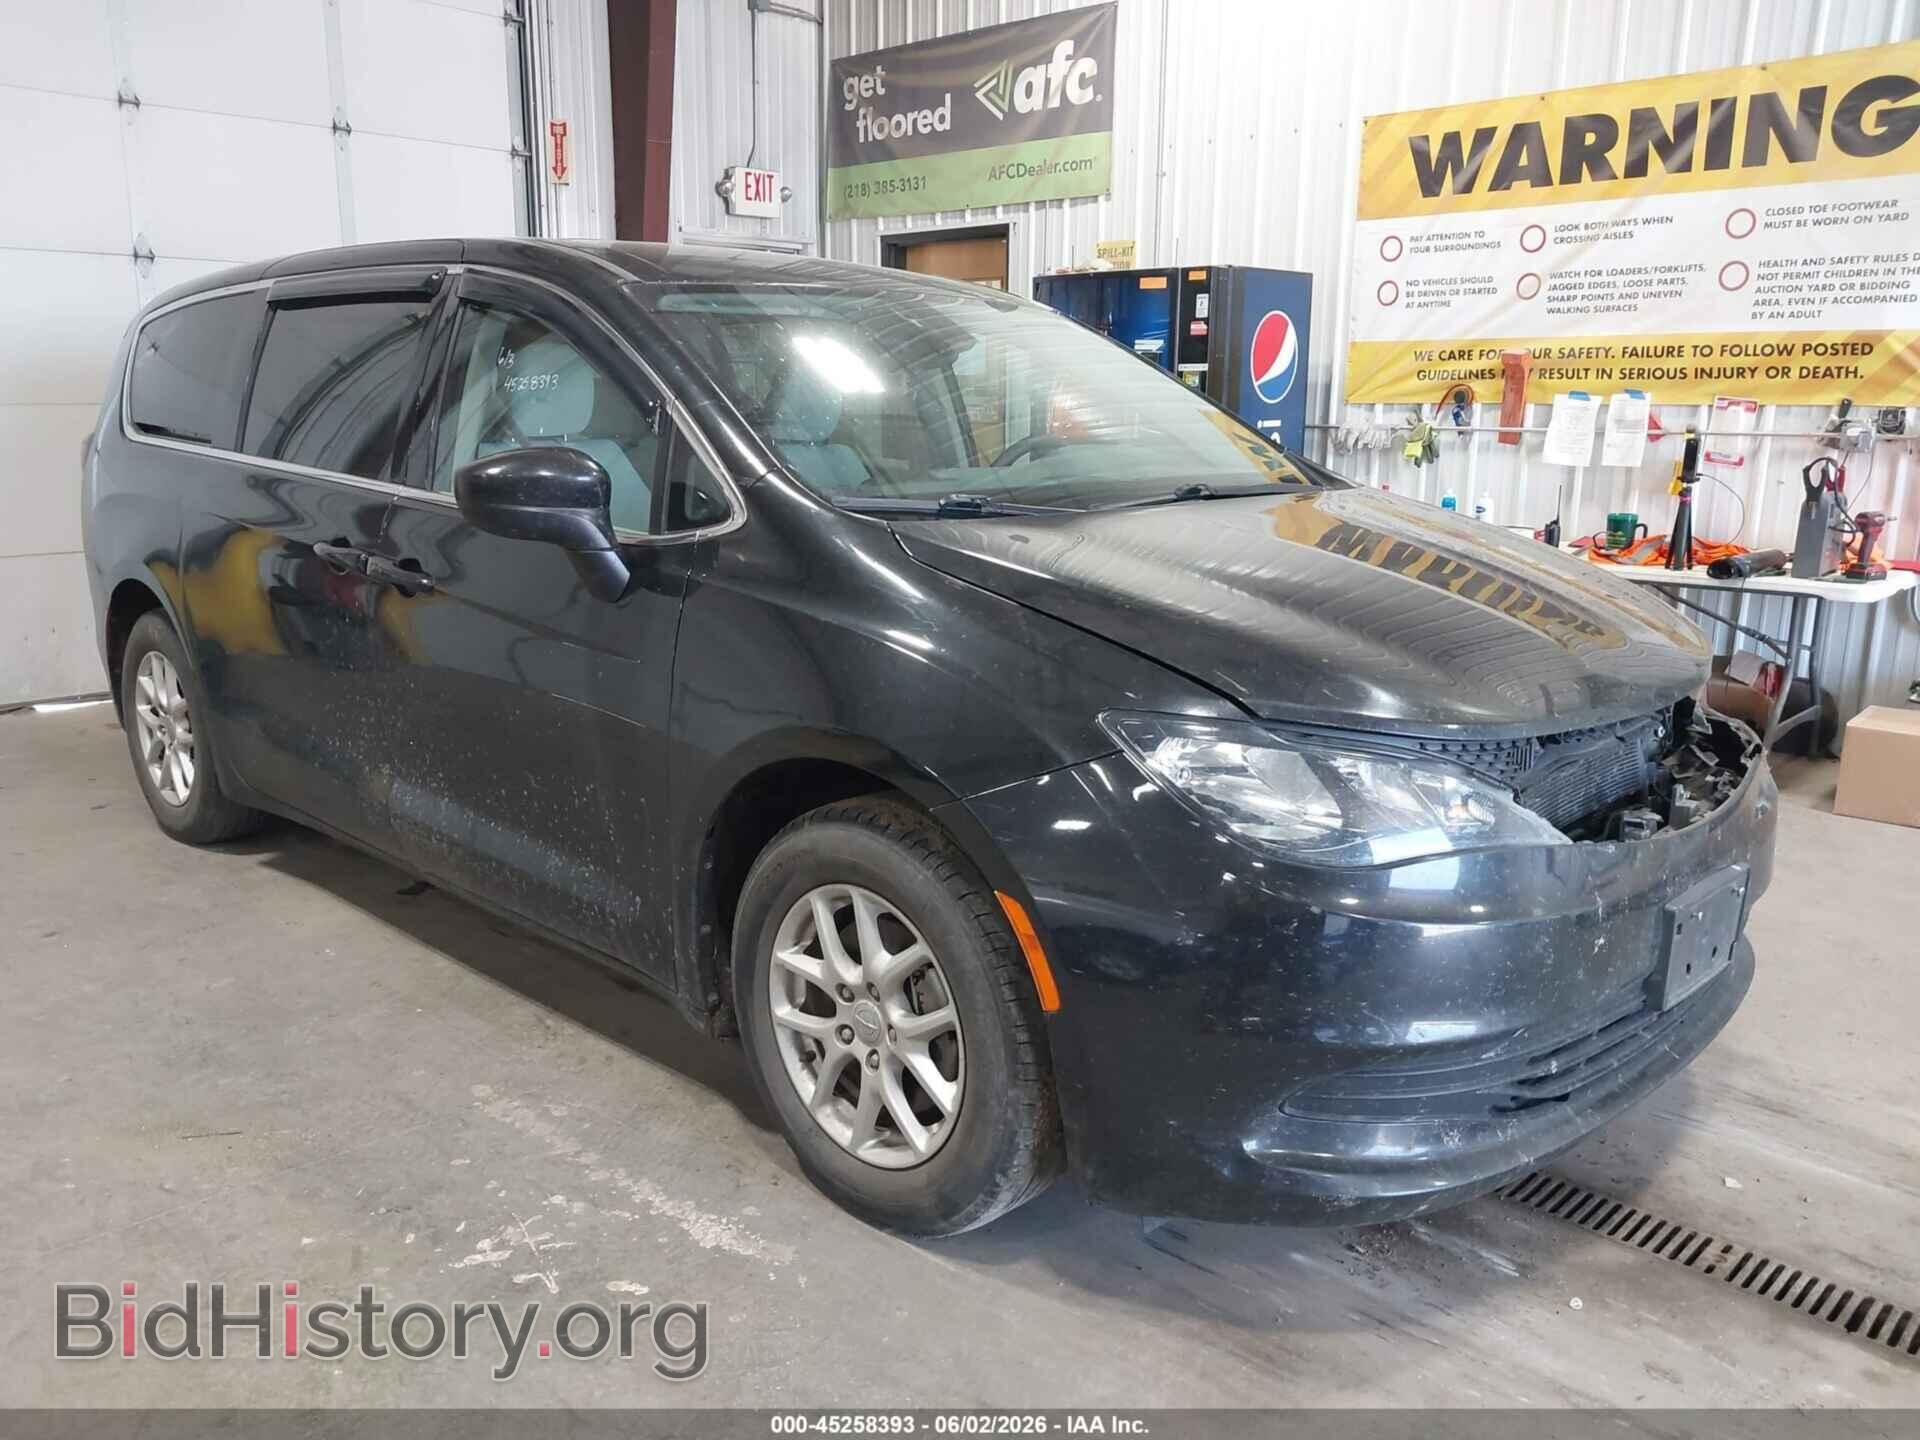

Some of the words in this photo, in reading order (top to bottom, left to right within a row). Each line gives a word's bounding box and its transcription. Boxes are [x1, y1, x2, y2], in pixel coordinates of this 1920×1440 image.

[843, 66, 885, 111] get
[856, 93, 951, 143] floored
[1408, 75, 1920, 198] WARNING
[989, 159, 1093, 181] AFCDealer.com
[745, 171, 774, 202] EXIT
[843, 180, 870, 200] (218)
[874, 176, 927, 195] 385-3131
[1765, 206, 1805, 217] CLOSED
[1809, 204, 1828, 214] TOE
[1832, 200, 1898, 212] FOOTWEAR
[1554, 224, 1580, 233] LOOK
[1584, 221, 1608, 231] BOTH
[1611, 218, 1639, 228] WAYS
[1642, 216, 1673, 225] WHEN
[1764, 220, 1793, 230] MUST
[1796, 219, 1809, 228] BE
[1812, 217, 1849, 227] WORN
[1854, 215, 1872, 224] ON
[1878, 212, 1909, 223] YARD
[1410, 235, 1424, 243] PAY
[1426, 232, 1472, 242] ATTENTION
[1474, 231, 1485, 239] TO
[1554, 234, 1601, 245] CROSSING
[1603, 231, 1634, 240] AISLES
[1410, 245, 1431, 254] YOUR
[1434, 241, 1501, 253] SURROUNDINGS
[1759, 259, 1798, 269] HEALTH
[1801, 258, 1826, 267] AND
[1830, 256, 1869, 265] SAFETY
[1873, 253, 1909, 263] RULES
[1550, 271, 1581, 280] WATCH
[1584, 270, 1603, 278] FOR
[1607, 264, 1706, 277] LOADERS/FORKLIFTS,
[1757, 273, 1780, 281] NOT
[1783, 271, 1821, 280] PERMIT
[1824, 268, 1879, 279] CHILDREN
[1882, 267, 1896, 276] IN
[1901, 266, 1920, 275] THE
[1423, 278, 1457, 286] VEHICLES
[1460, 276, 1494, 285] SHOULD
[1548, 282, 1584, 292] JAGGED
[1624, 279, 1653, 288] LOOSE
[1657, 277, 1689, 287] PARTS,
[1755, 285, 1803, 294] AUCTION
[1807, 283, 1836, 292] YARD
[1839, 283, 1856, 292] OR
[1860, 280, 1911, 291] BIDDING
[1463, 287, 1498, 296] STARTED
[1547, 295, 1577, 303] SHARP
[1581, 293, 1615, 302] POINTS
[1618, 292, 1639, 300] AND
[1643, 290, 1683, 299] UNEVEN
[1417, 300, 1451, 308] ANYTIME
[1788, 297, 1815, 306] EVEN
[1819, 297, 1828, 305] IF
[1831, 294, 1918, 305] ACCOMPANIED
[1546, 306, 1590, 315] WALKING
[1593, 304, 1639, 313] SURFACES
[1751, 312, 1765, 320] BY
[1768, 311, 1785, 320] AN
[1788, 310, 1822, 319] ADULT
[1414, 350, 1434, 362] WE
[1439, 349, 1473, 361] CARE
[1557, 347, 1616, 360] SAFETY.
[1621, 345, 1685, 359] FAILURE
[1692, 344, 1713, 358] TO
[1720, 343, 1796, 358] FOLLOW
[1801, 342, 1874, 356] POSTED
[1417, 368, 1496, 381] GUIDELINES
[1539, 368, 1591, 380] RESULT
[1596, 368, 1613, 380] IN
[1619, 367, 1688, 380] SERIOUS
[1694, 366, 1759, 380] INJURY
[1765, 366, 1792, 379] OR
[1799, 366, 1864, 379] DEATH.
